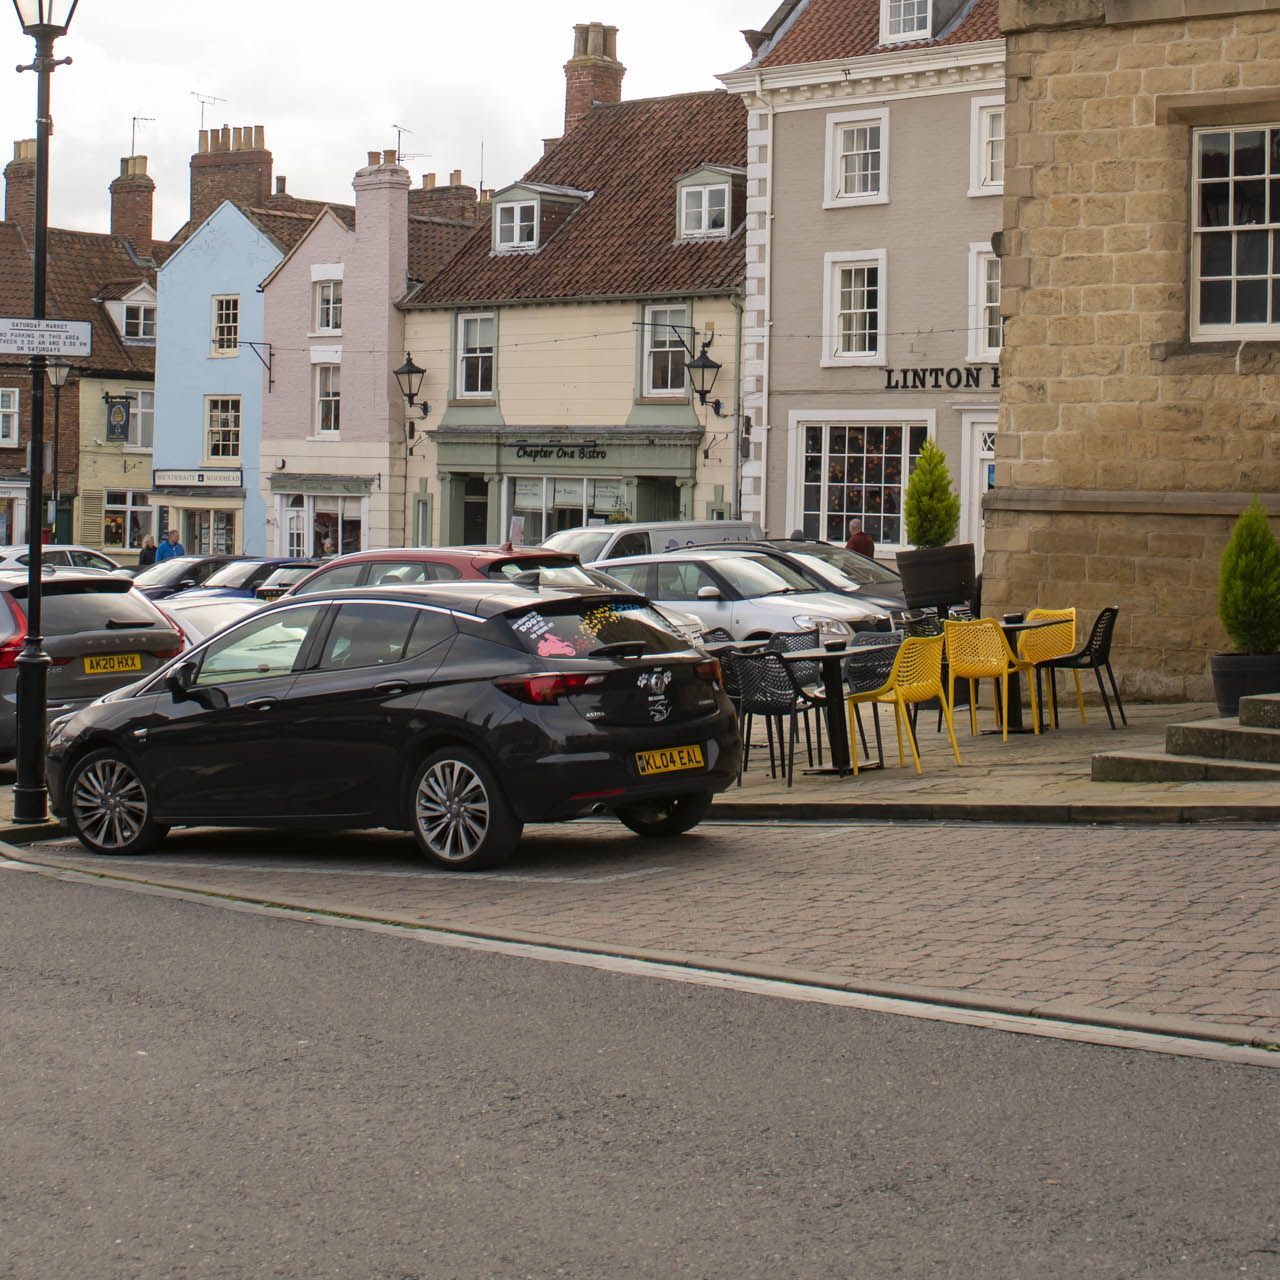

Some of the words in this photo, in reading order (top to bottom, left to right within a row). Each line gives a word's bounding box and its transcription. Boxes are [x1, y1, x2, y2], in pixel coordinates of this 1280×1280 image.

[884, 366, 983, 390] LINTON
[516, 447, 554, 462] Chapter
[556, 447, 576, 459] One
[578, 447, 607, 459] Bistro
[89, 658, 116, 670] AK20
[117, 656, 137, 669] HXX
[644, 752, 676, 770] KL04
[677, 748, 701, 766] EAL
